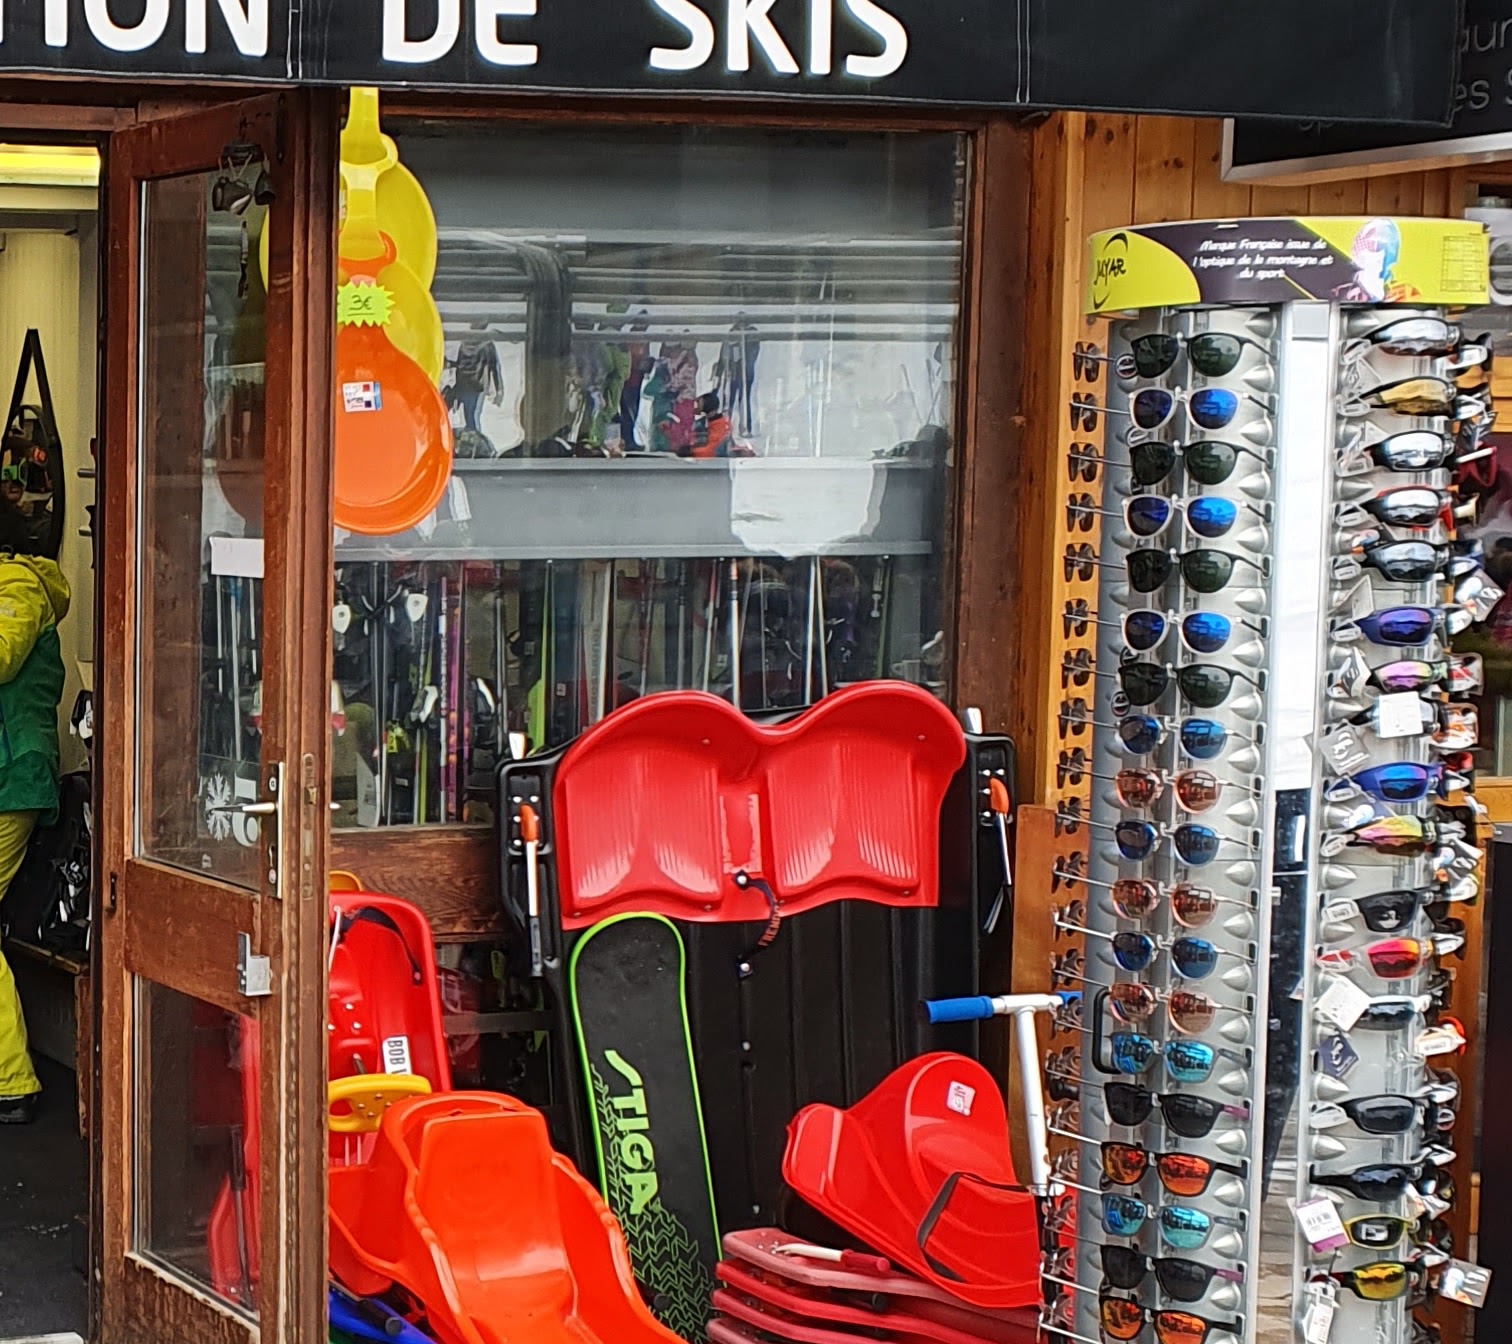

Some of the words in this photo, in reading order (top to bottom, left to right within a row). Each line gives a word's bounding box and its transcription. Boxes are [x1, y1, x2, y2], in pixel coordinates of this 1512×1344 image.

[1312, 238, 1327, 249] de
[1237, 254, 1251, 265] de
[1266, 256, 1317, 268] montagne
[1239, 267, 1254, 278] du
[348, 295, 372, 310] 3€
[387, 1040, 405, 1065] BOB
[604, 1050, 659, 1216] STIGA
